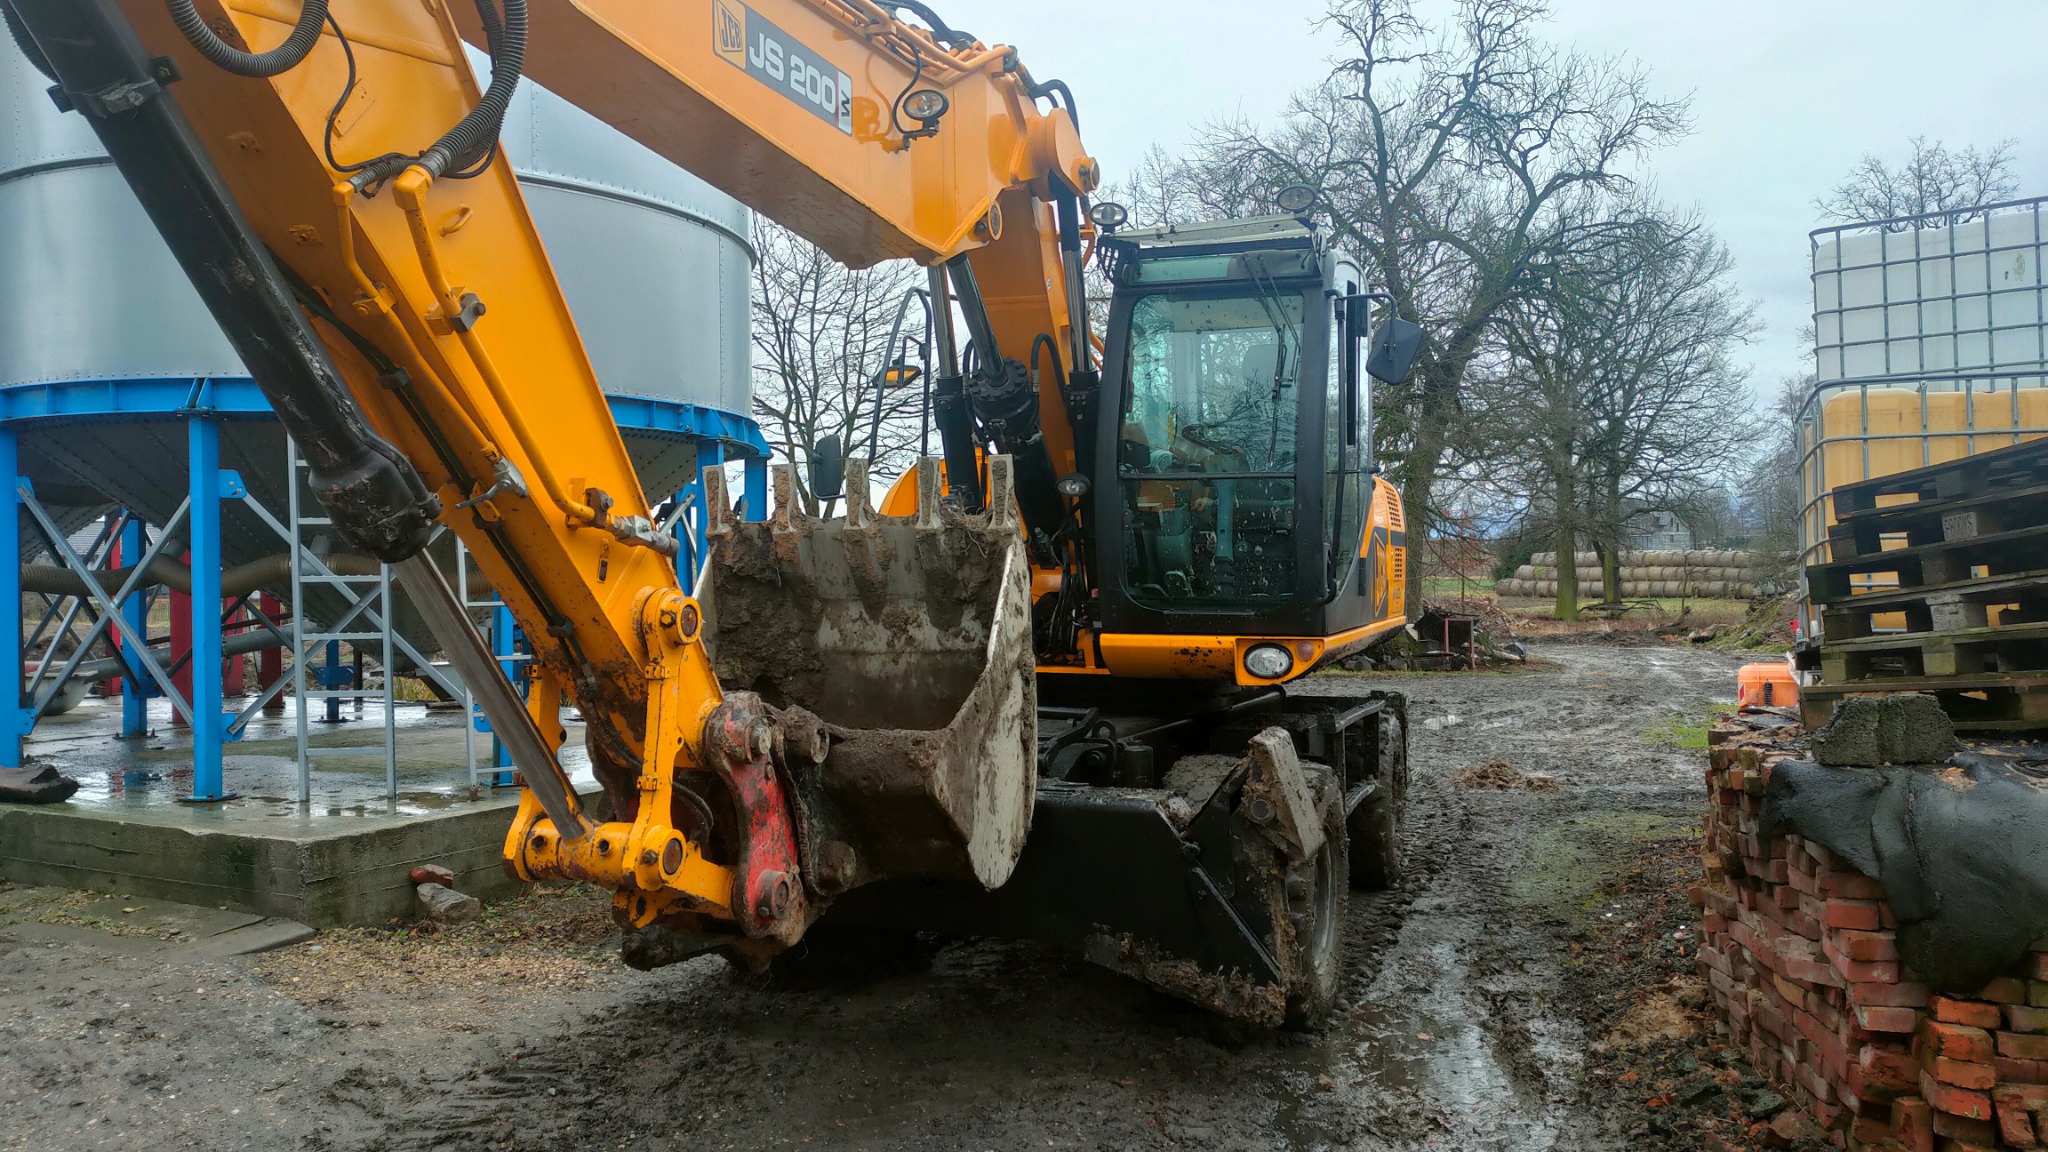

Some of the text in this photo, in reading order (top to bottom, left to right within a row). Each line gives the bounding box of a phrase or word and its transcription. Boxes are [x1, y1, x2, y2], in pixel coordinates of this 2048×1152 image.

[721, 7, 742, 49] JCB
[749, 32, 784, 81] JS
[790, 54, 836, 114] 200
